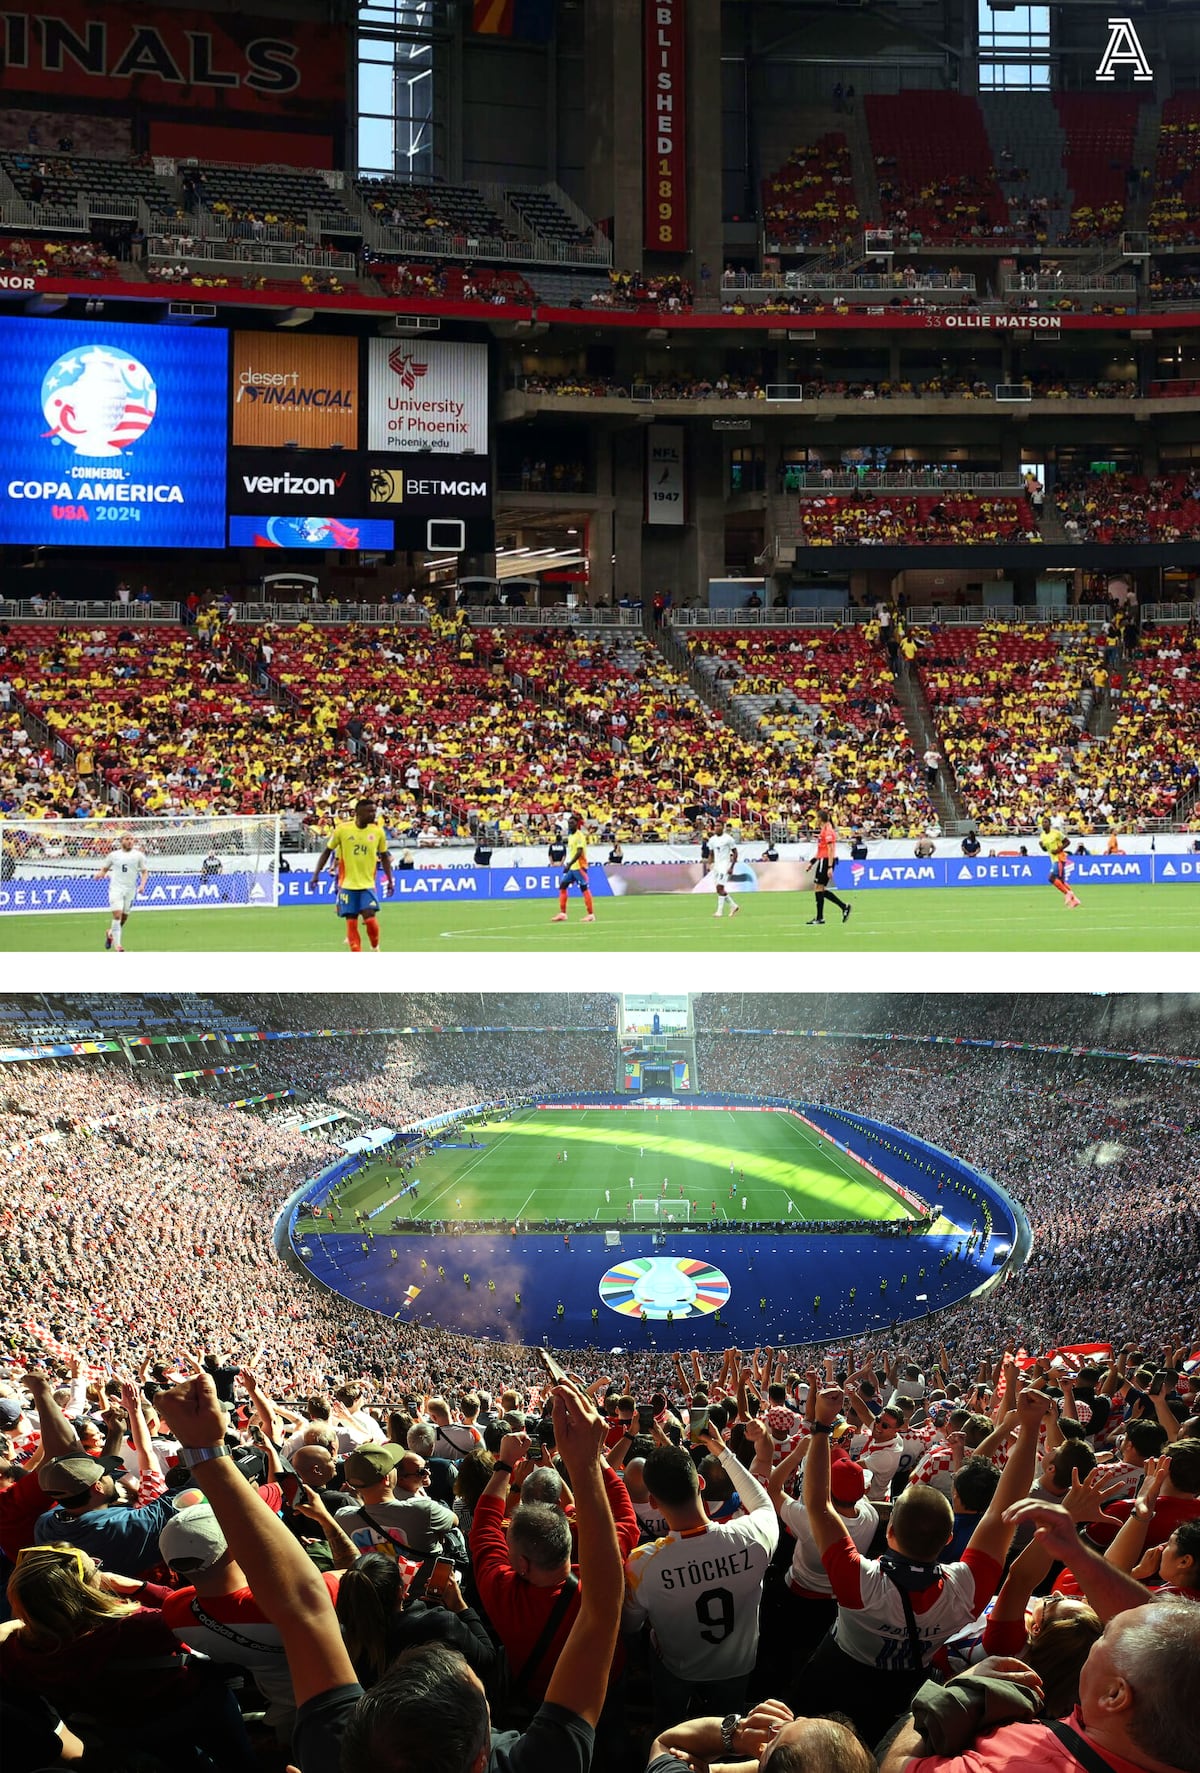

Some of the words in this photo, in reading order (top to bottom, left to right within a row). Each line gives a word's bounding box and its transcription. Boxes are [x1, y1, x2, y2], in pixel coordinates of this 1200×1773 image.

[2, 11, 301, 94] INALS
[656, 0, 673, 154] BLISHED
[658, 159, 672, 242] 1898
[924, 316, 941, 328] 33
[945, 316, 991, 327] OLLIE
[995, 316, 1061, 327] MATSON
[239, 366, 300, 386] desert
[246, 386, 352, 407] FINANCIAL
[387, 397, 465, 417] University
[387, 416, 404, 431] of
[407, 417, 470, 433] Phoenix
[387, 436, 450, 448] Phoenix.edu
[652, 448, 680, 459] NFL
[7, 480, 74, 500] COPA
[77, 483, 185, 503] AMERICA
[242, 472, 335, 495] verizon
[406, 479, 488, 496] BETMGM
[652, 491, 680, 502] 1947
[51, 505, 90, 522] USA
[95, 506, 141, 522] 2024
[353, 844, 368, 855] 24
[121, 863, 128, 873] 6
[868, 866, 935, 881] LATAM
[976, 864, 1033, 878] DELTA
[1078, 862, 1141, 877] LATAM
[400, 877, 477, 893] LATAM
[661, 1549, 754, 1590] STÖCKEZ
[695, 1587, 735, 1645] 9
[199, 1613, 235, 1639] adidas
